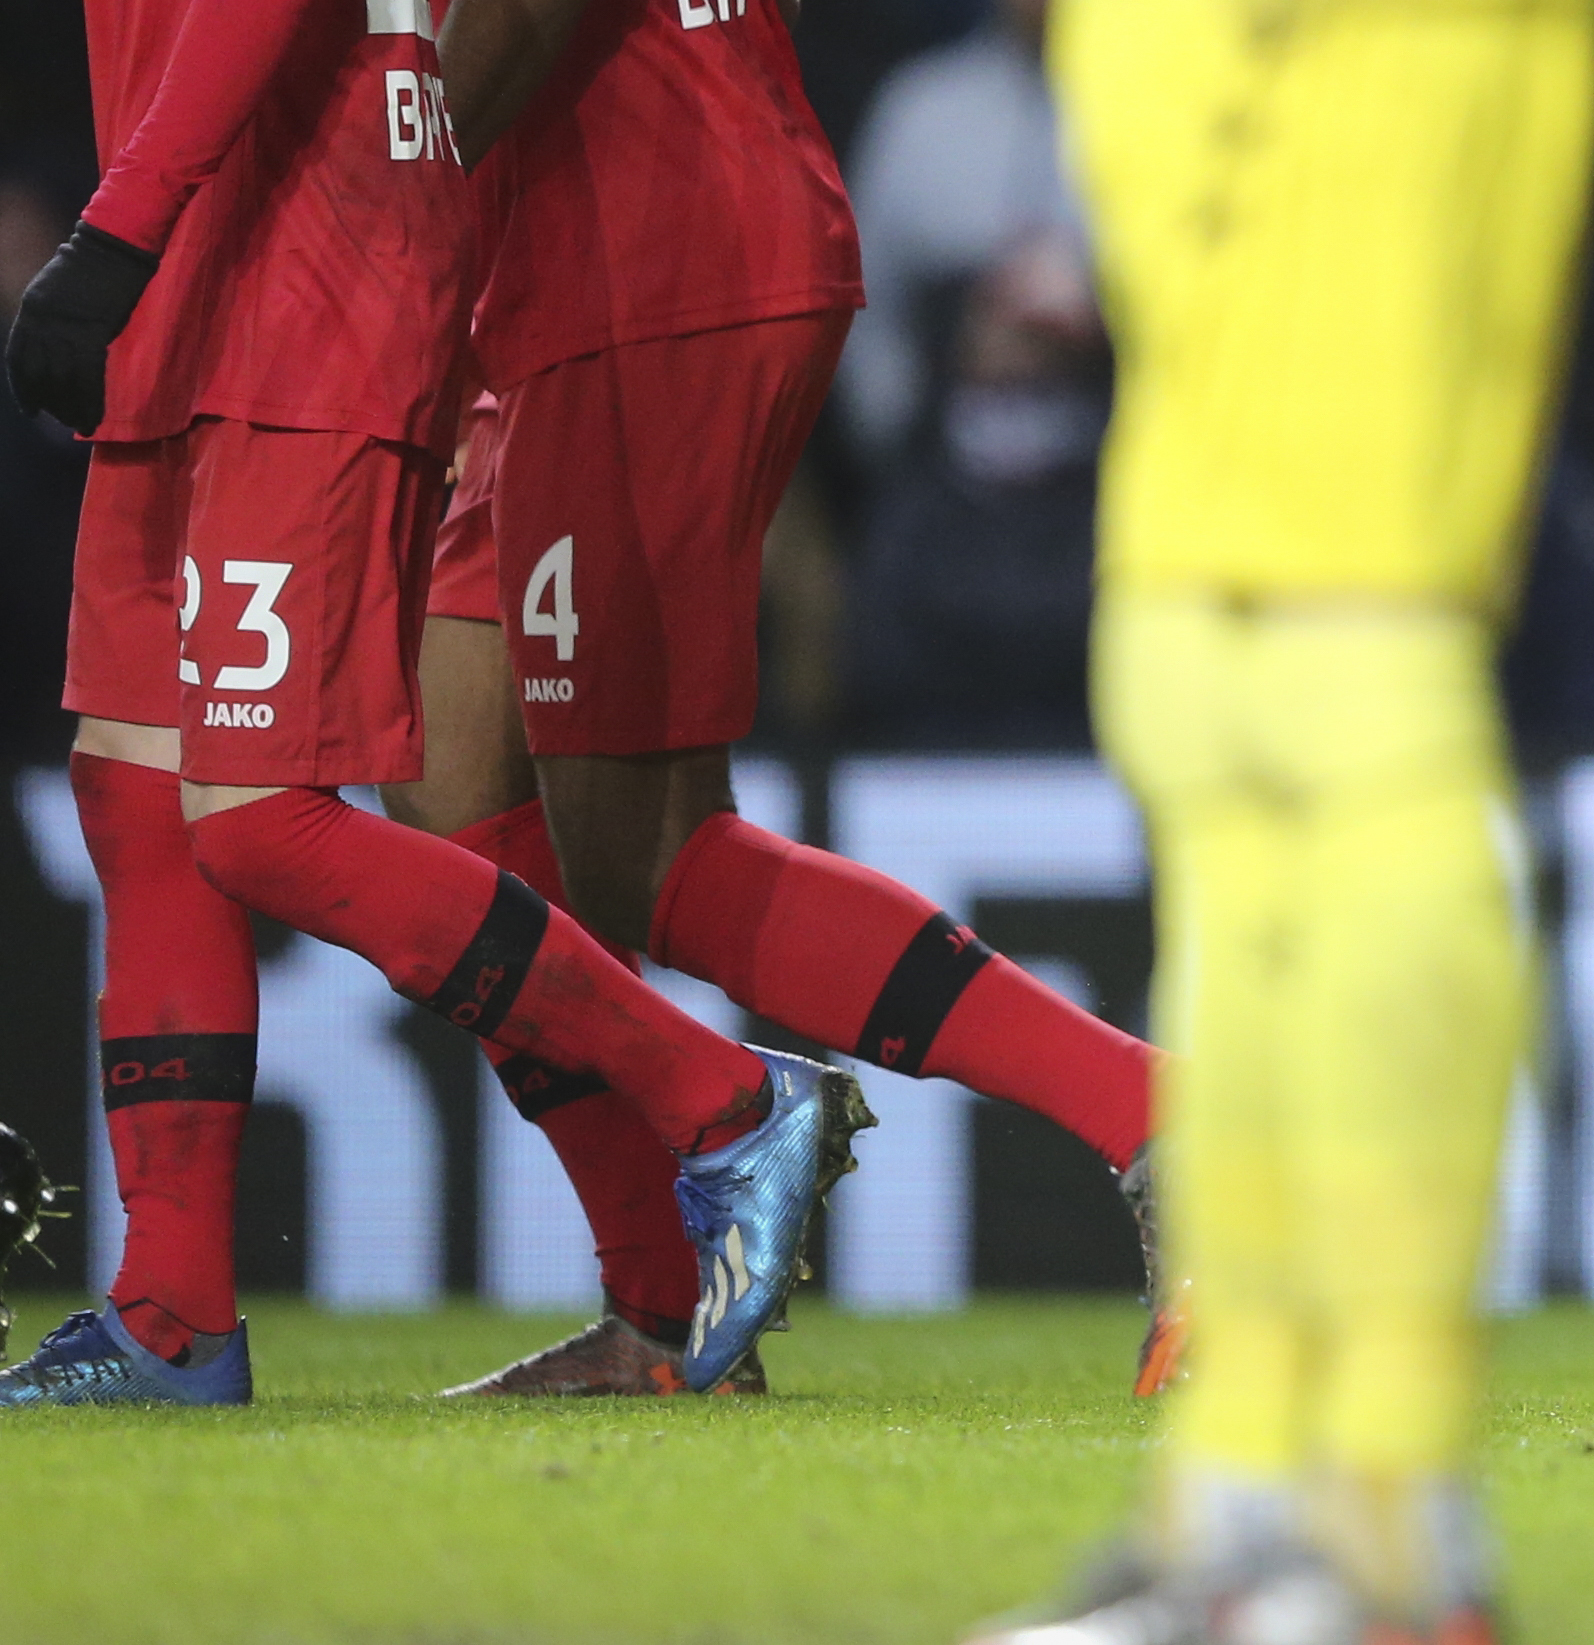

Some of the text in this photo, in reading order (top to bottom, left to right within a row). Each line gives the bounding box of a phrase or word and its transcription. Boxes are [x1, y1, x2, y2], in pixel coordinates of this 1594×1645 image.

[522, 534, 579, 661] 4
[524, 677, 575, 703] JAKO
[203, 702, 275, 729] JAKO
